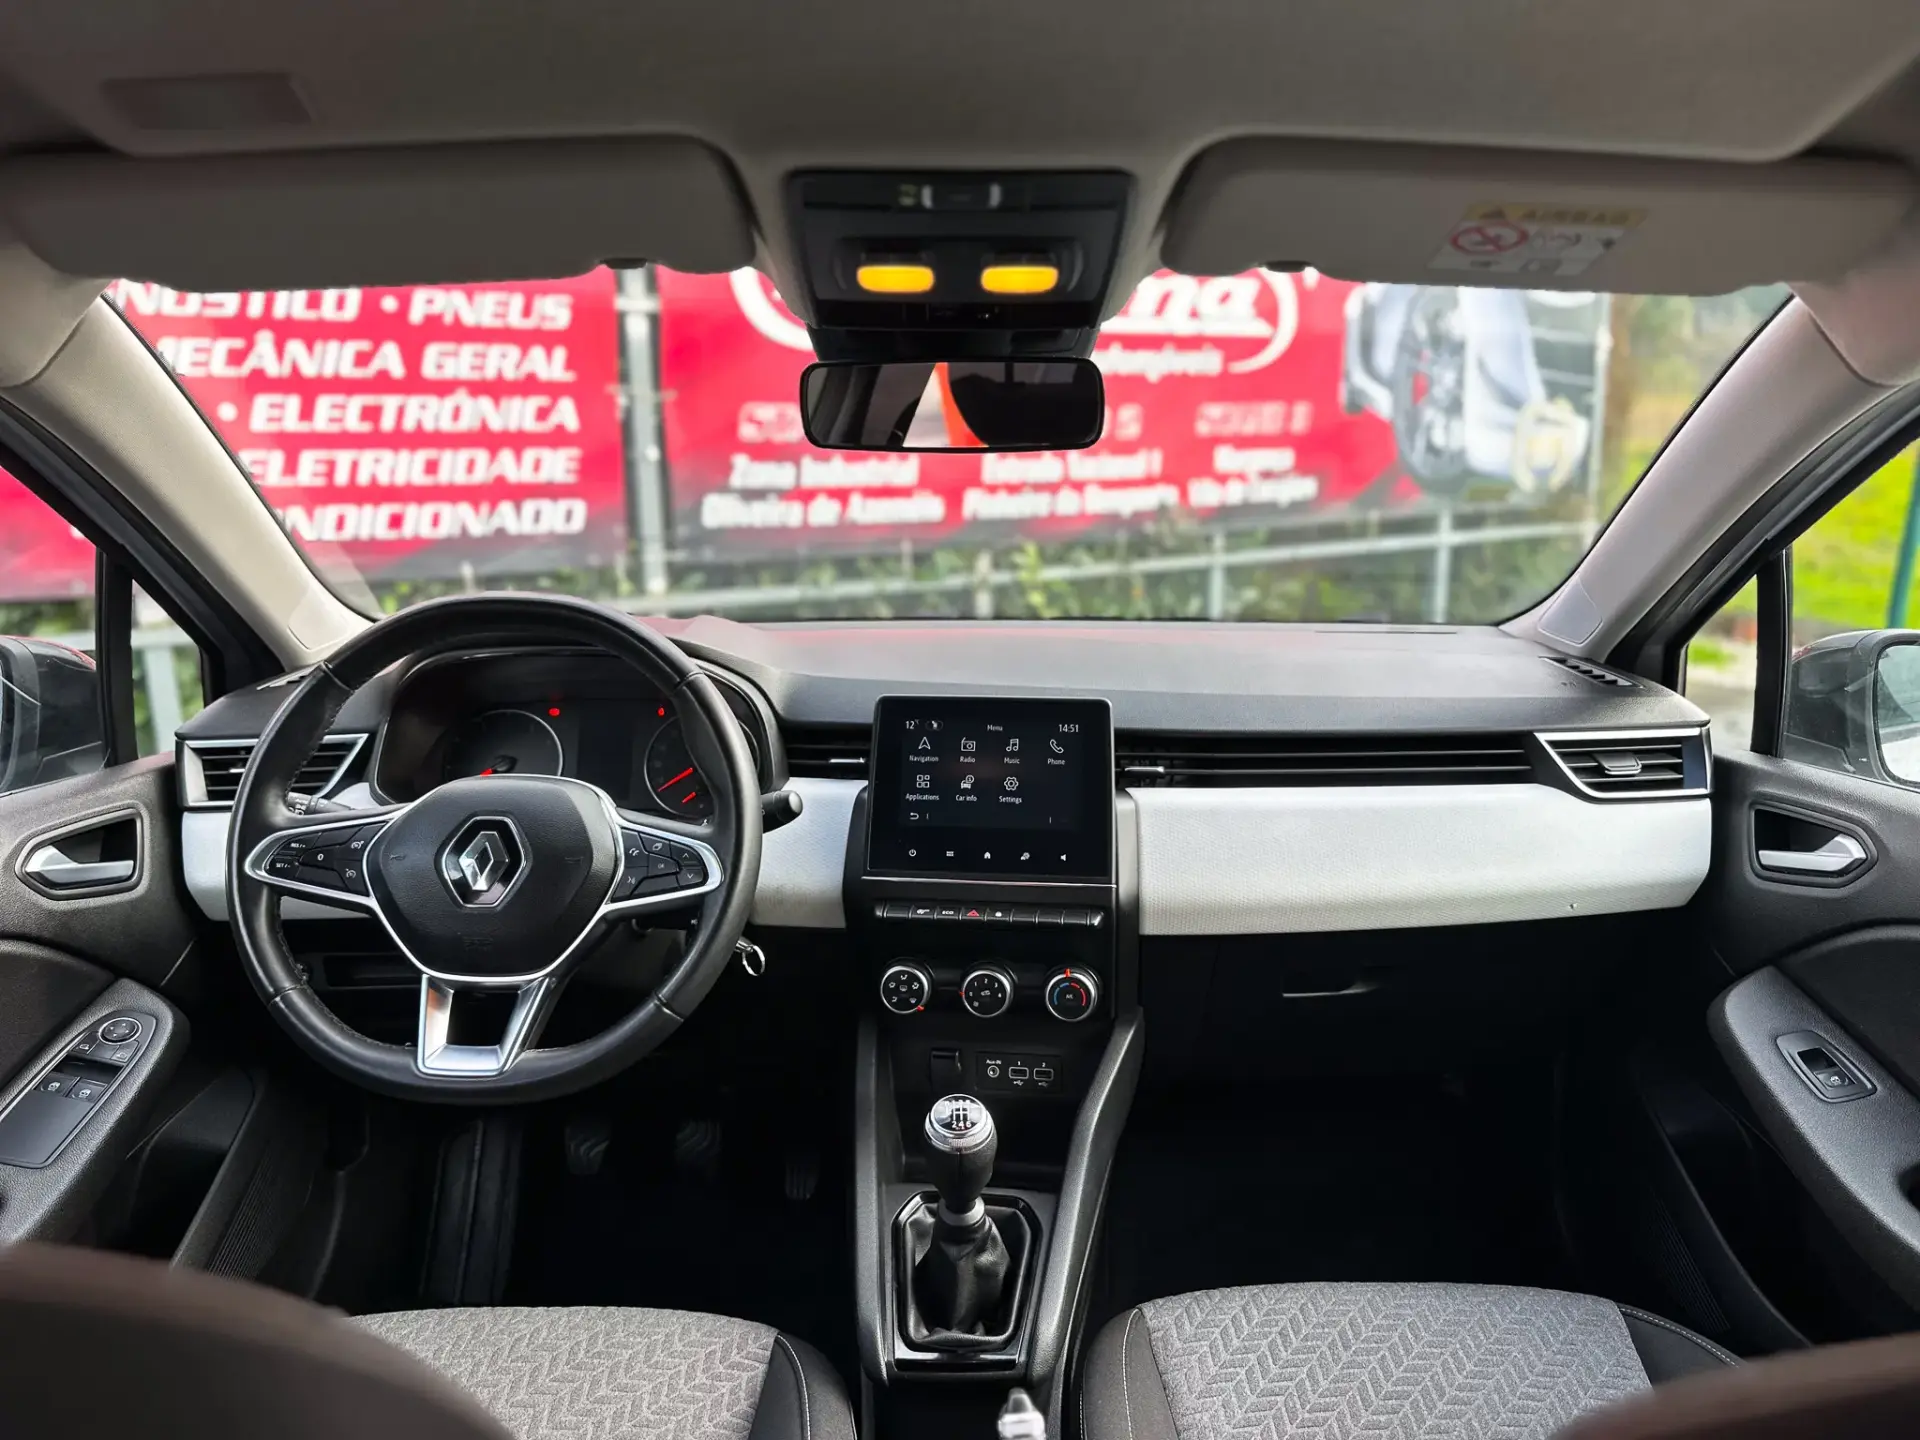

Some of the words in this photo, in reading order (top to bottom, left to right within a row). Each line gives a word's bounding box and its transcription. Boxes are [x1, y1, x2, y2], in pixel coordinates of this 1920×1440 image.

[407, 288, 574, 331] PNEUS
[420, 340, 578, 383] GERAL
[236, 445, 583, 488] ELETRICIDADE
[276, 497, 588, 542] NDICIONADO
[1058, 723, 1079, 733] 14:51
[909, 755, 939, 763] Navigation
[1047, 758, 1066, 766] Phone
[905, 793, 940, 802] Applications
[955, 794, 966, 802] Car
[998, 795, 1022, 804] Settings
[951, 1120, 958, 1129] 2
